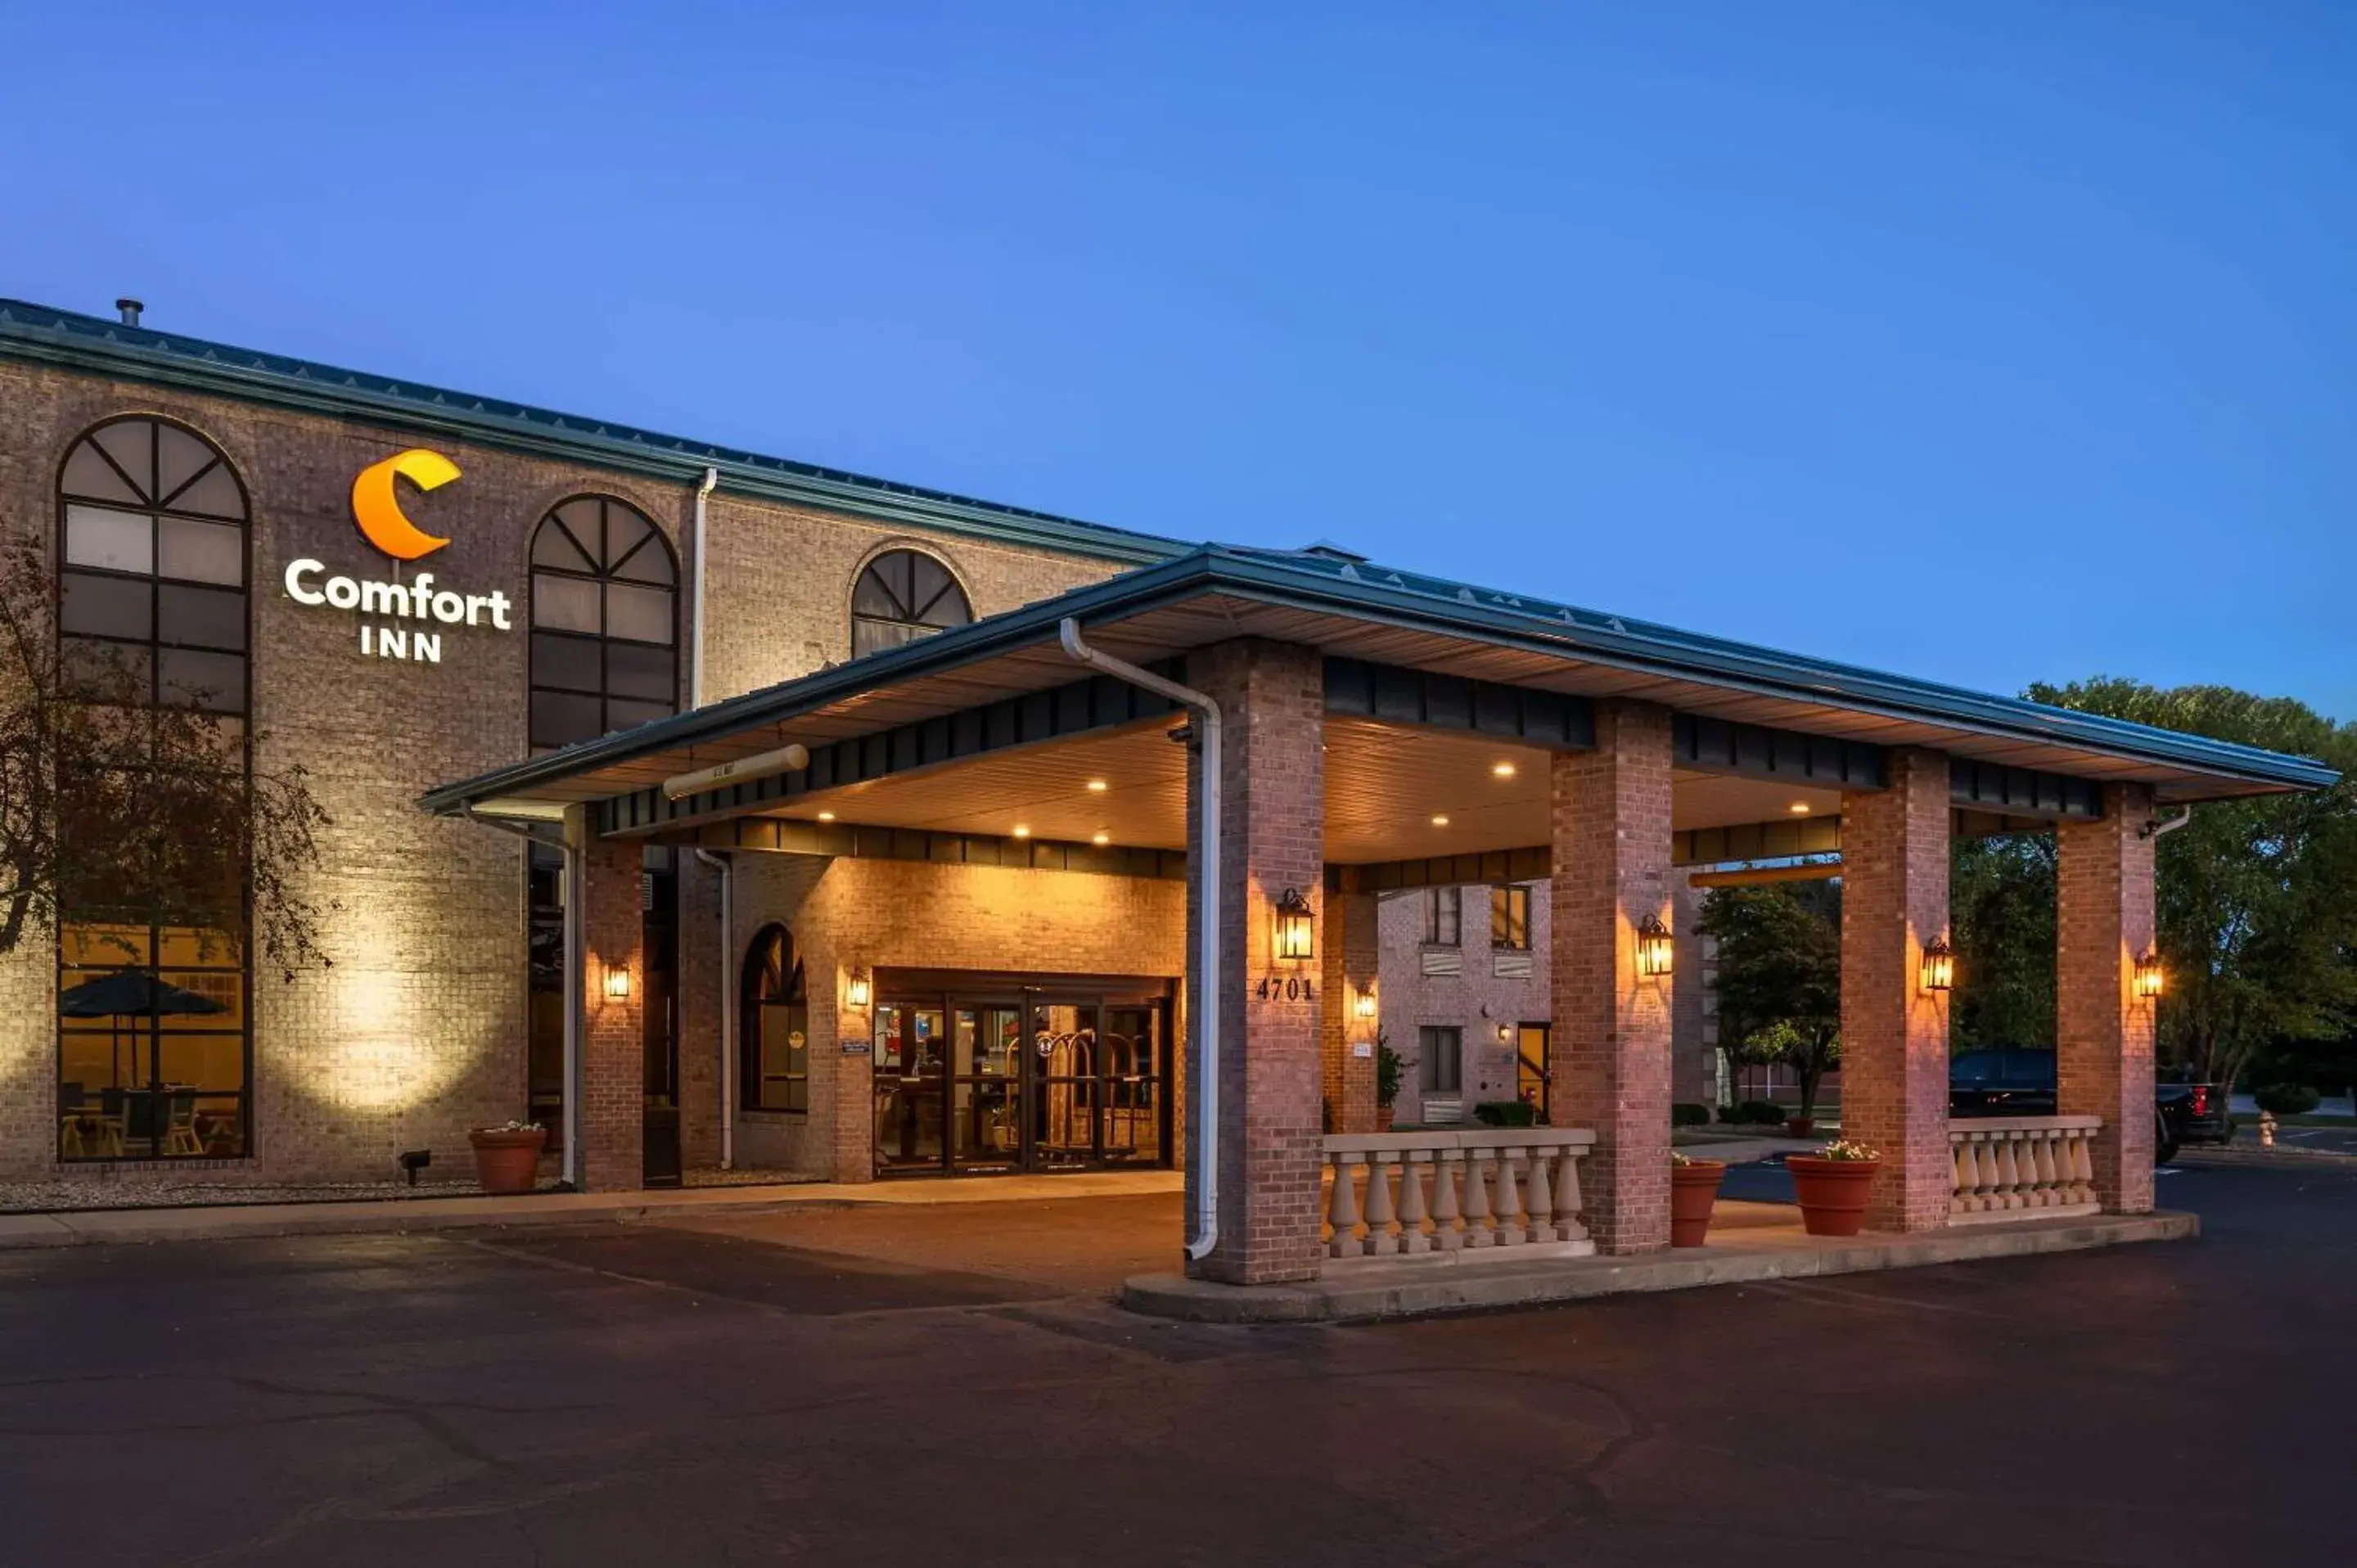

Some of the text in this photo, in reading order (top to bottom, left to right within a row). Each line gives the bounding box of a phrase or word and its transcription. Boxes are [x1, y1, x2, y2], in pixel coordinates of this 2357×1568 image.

[285, 558, 512, 630] Comfort
[360, 625, 441, 663] INN
[1256, 978, 1314, 1000] 4701
